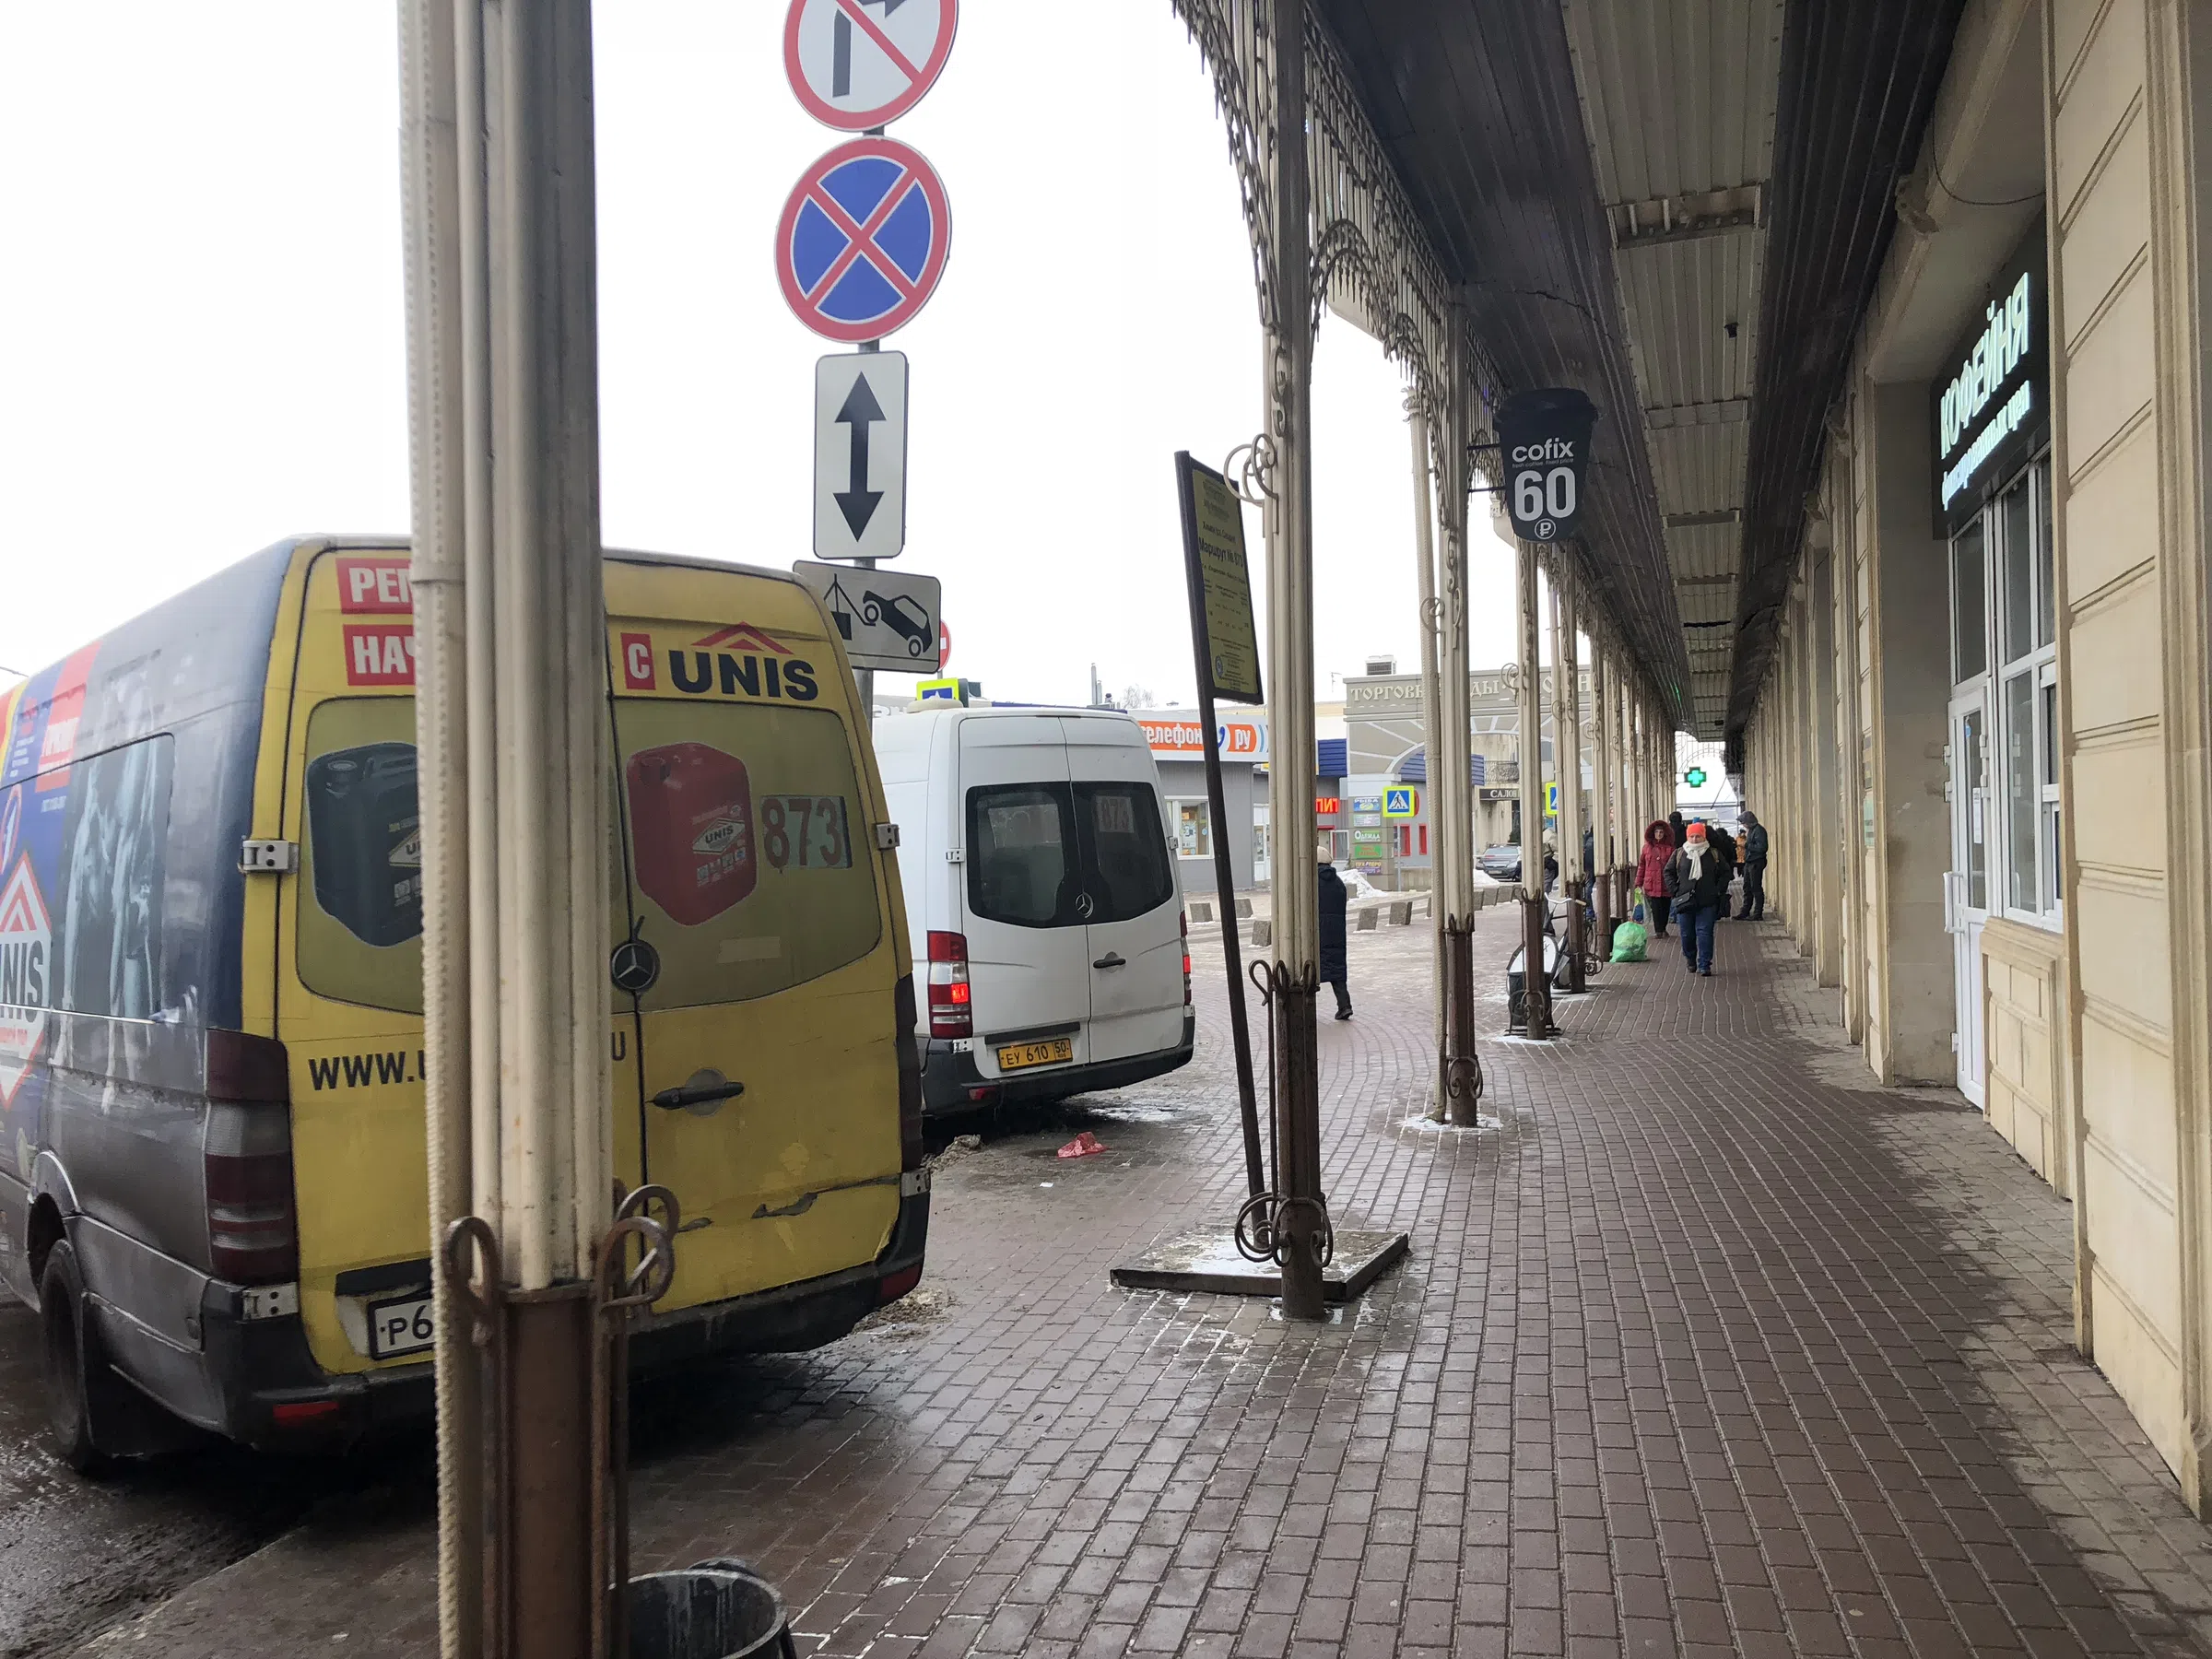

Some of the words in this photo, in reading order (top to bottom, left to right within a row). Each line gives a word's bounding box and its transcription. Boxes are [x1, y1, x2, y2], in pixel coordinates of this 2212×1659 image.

[1940, 271, 2029, 460] КОФЕЙНЯ
[1512, 437, 1574, 462] cofix
[1514, 466, 1576, 522] 60
[668, 649, 818, 701] UNIS
[1234, 728, 1251, 750] ру
[705, 824, 735, 844] UNIS
[760, 798, 842, 868] 873
[0, 940, 43, 1023] NIS
[1026, 1045, 1049, 1062] 610
